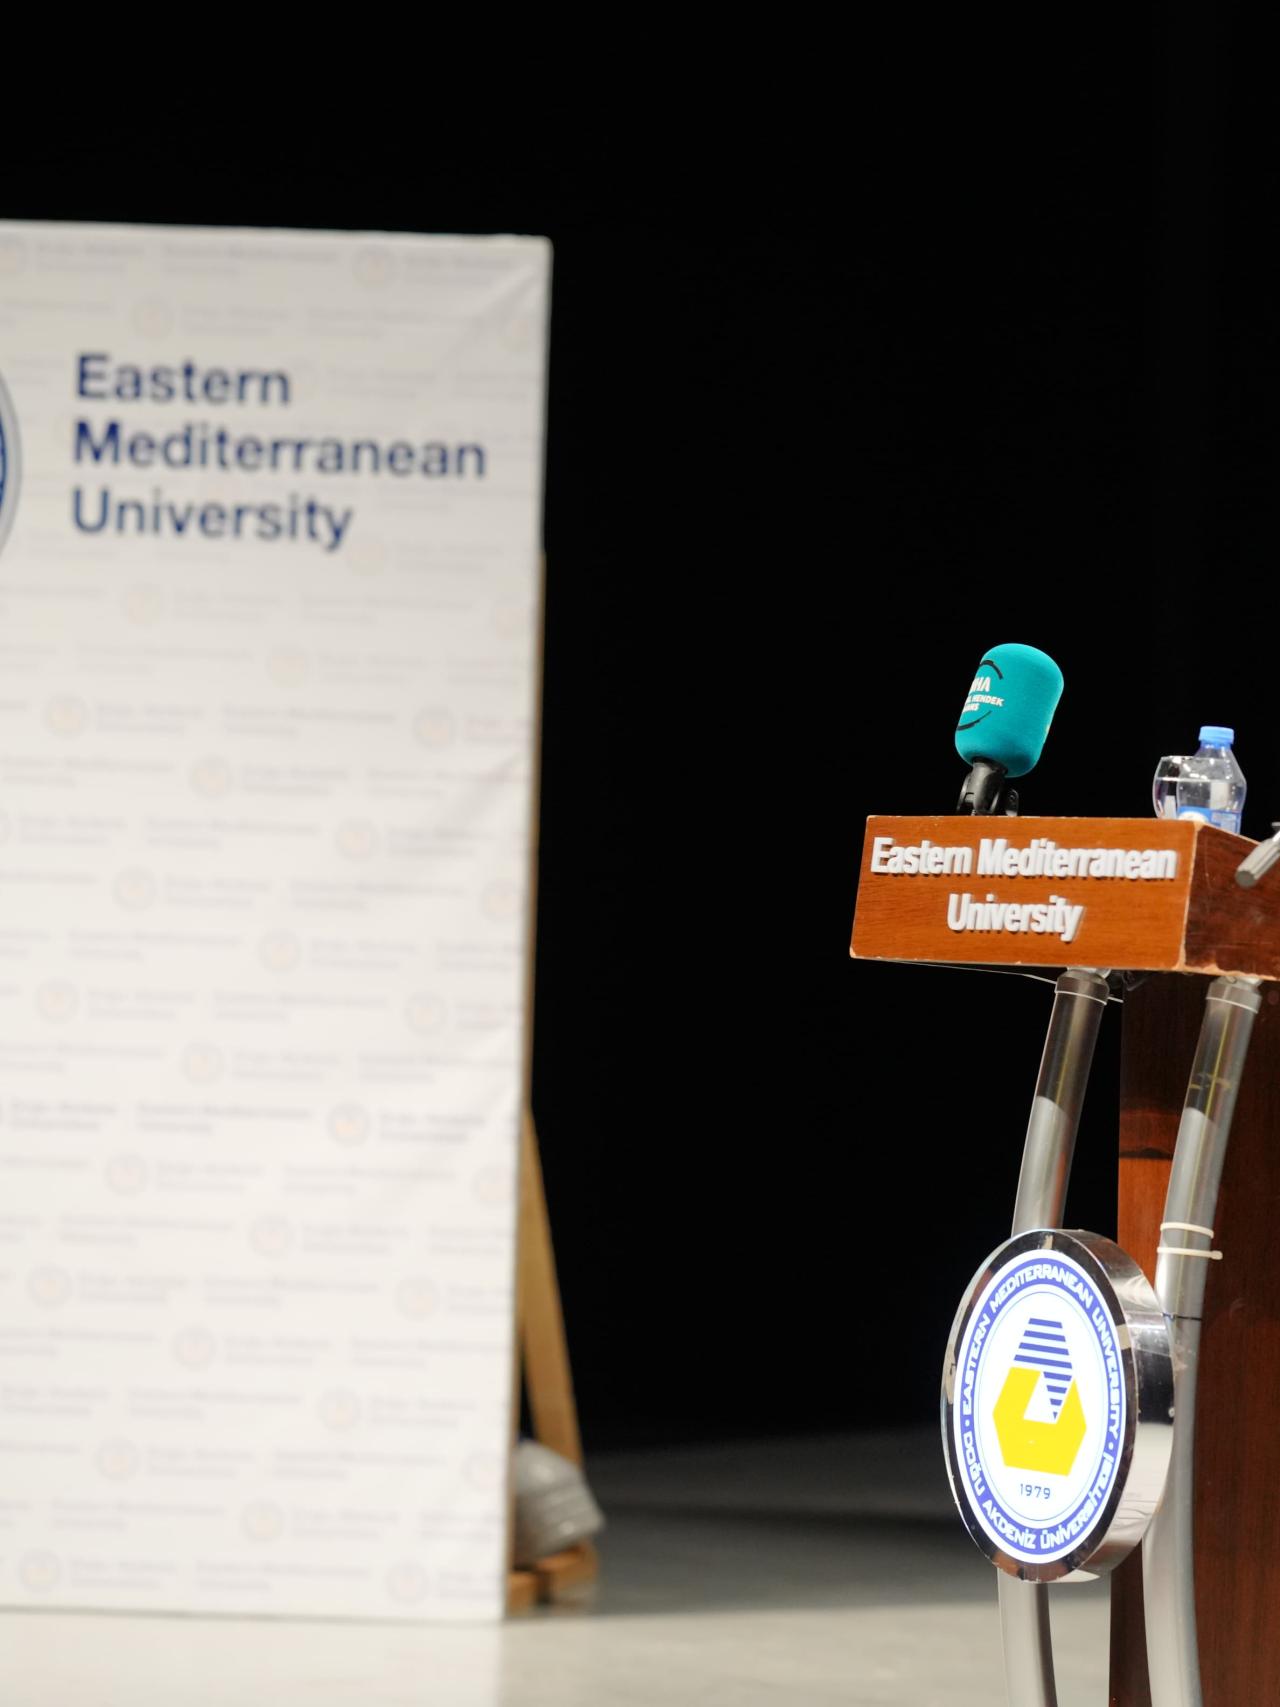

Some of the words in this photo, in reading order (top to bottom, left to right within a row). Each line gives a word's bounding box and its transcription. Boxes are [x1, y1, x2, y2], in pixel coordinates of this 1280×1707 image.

[77, 353, 290, 405] Eastern
[73, 420, 487, 477] Mediterranean
[72, 487, 352, 552] University
[871, 837, 972, 875] Eastern
[976, 838, 1177, 879] Mediterranean
[947, 893, 1084, 942] University
[963, 1313, 991, 1416] EASTERN
[989, 1264, 1093, 1313] MEDITERRANEAN
[1091, 1307, 1120, 1440] UNIVERSITY
[963, 1431, 986, 1497] DOĞU
[982, 1500, 1037, 1549] AKDENİZ
[1020, 1484, 1051, 1499] 1979
